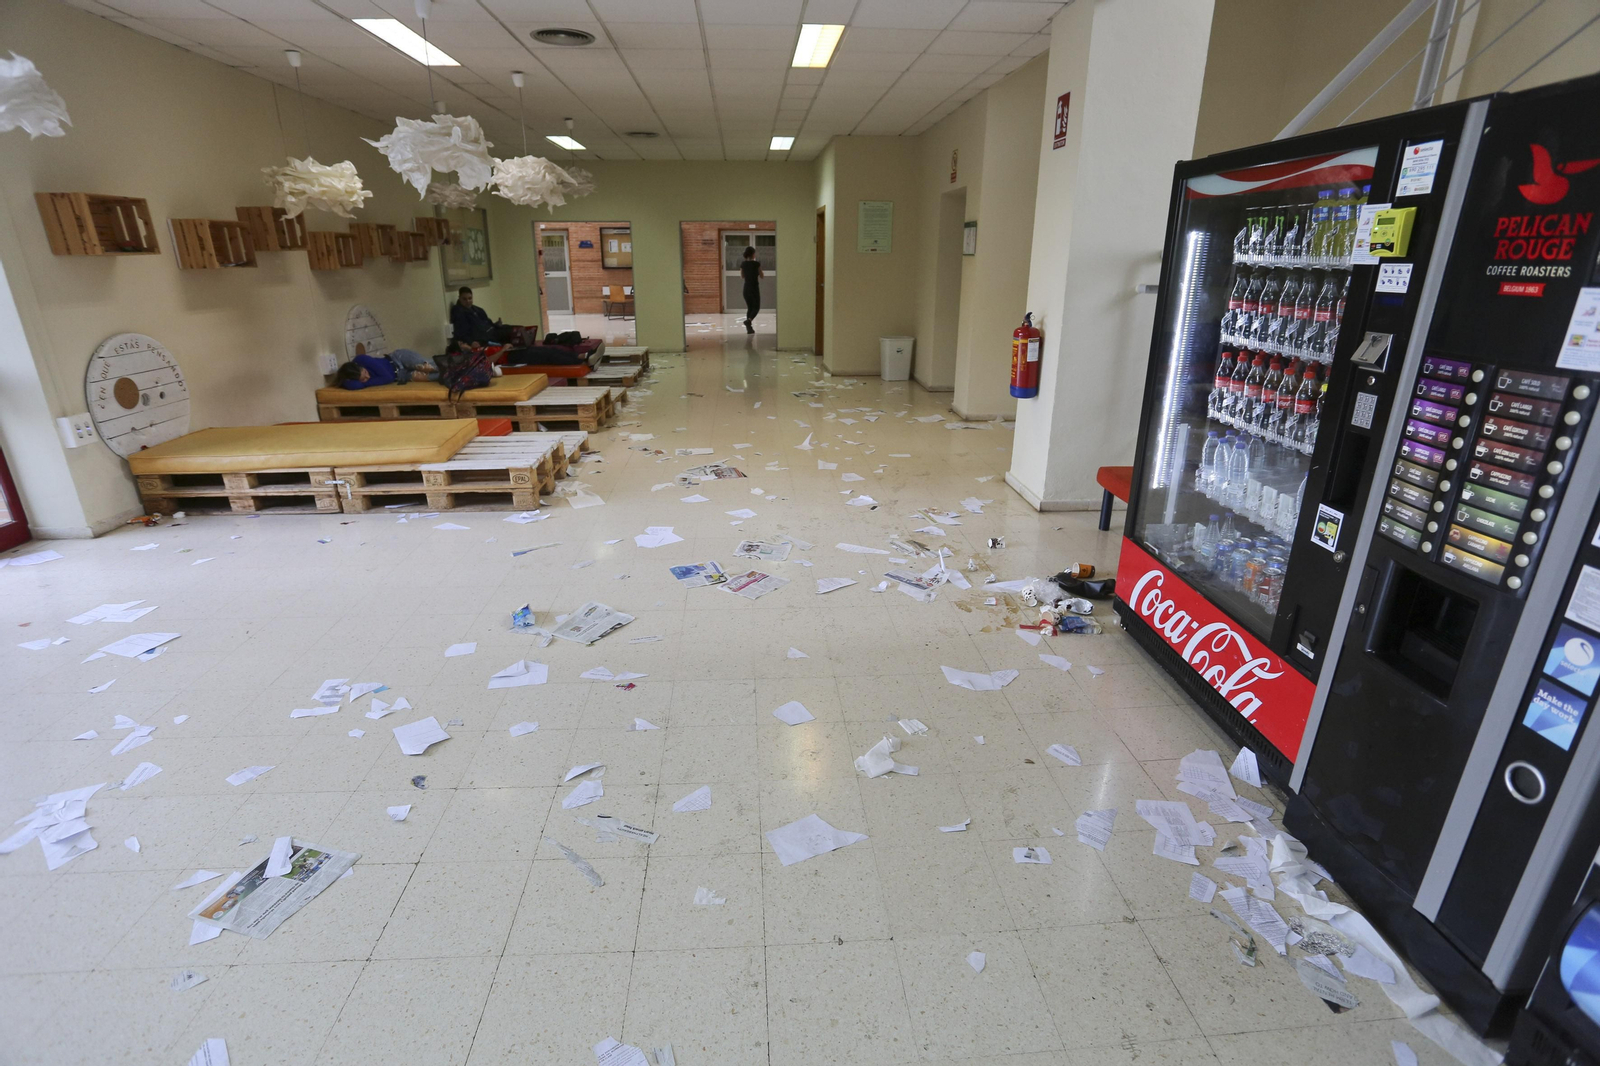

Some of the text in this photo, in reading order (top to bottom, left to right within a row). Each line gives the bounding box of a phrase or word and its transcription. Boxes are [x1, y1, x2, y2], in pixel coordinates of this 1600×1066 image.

[1493, 212, 1593, 237] PELICAN
[1494, 238, 1576, 260] ROUGE
[1486, 265, 1572, 277] COFFEE ROASTERS
[1511, 401, 1521, 409] CAFÉ
[1476, 516, 1496, 528] CHOCOLATE
[1533, 696, 1551, 711] day
[1537, 688, 1579, 717] Make the
